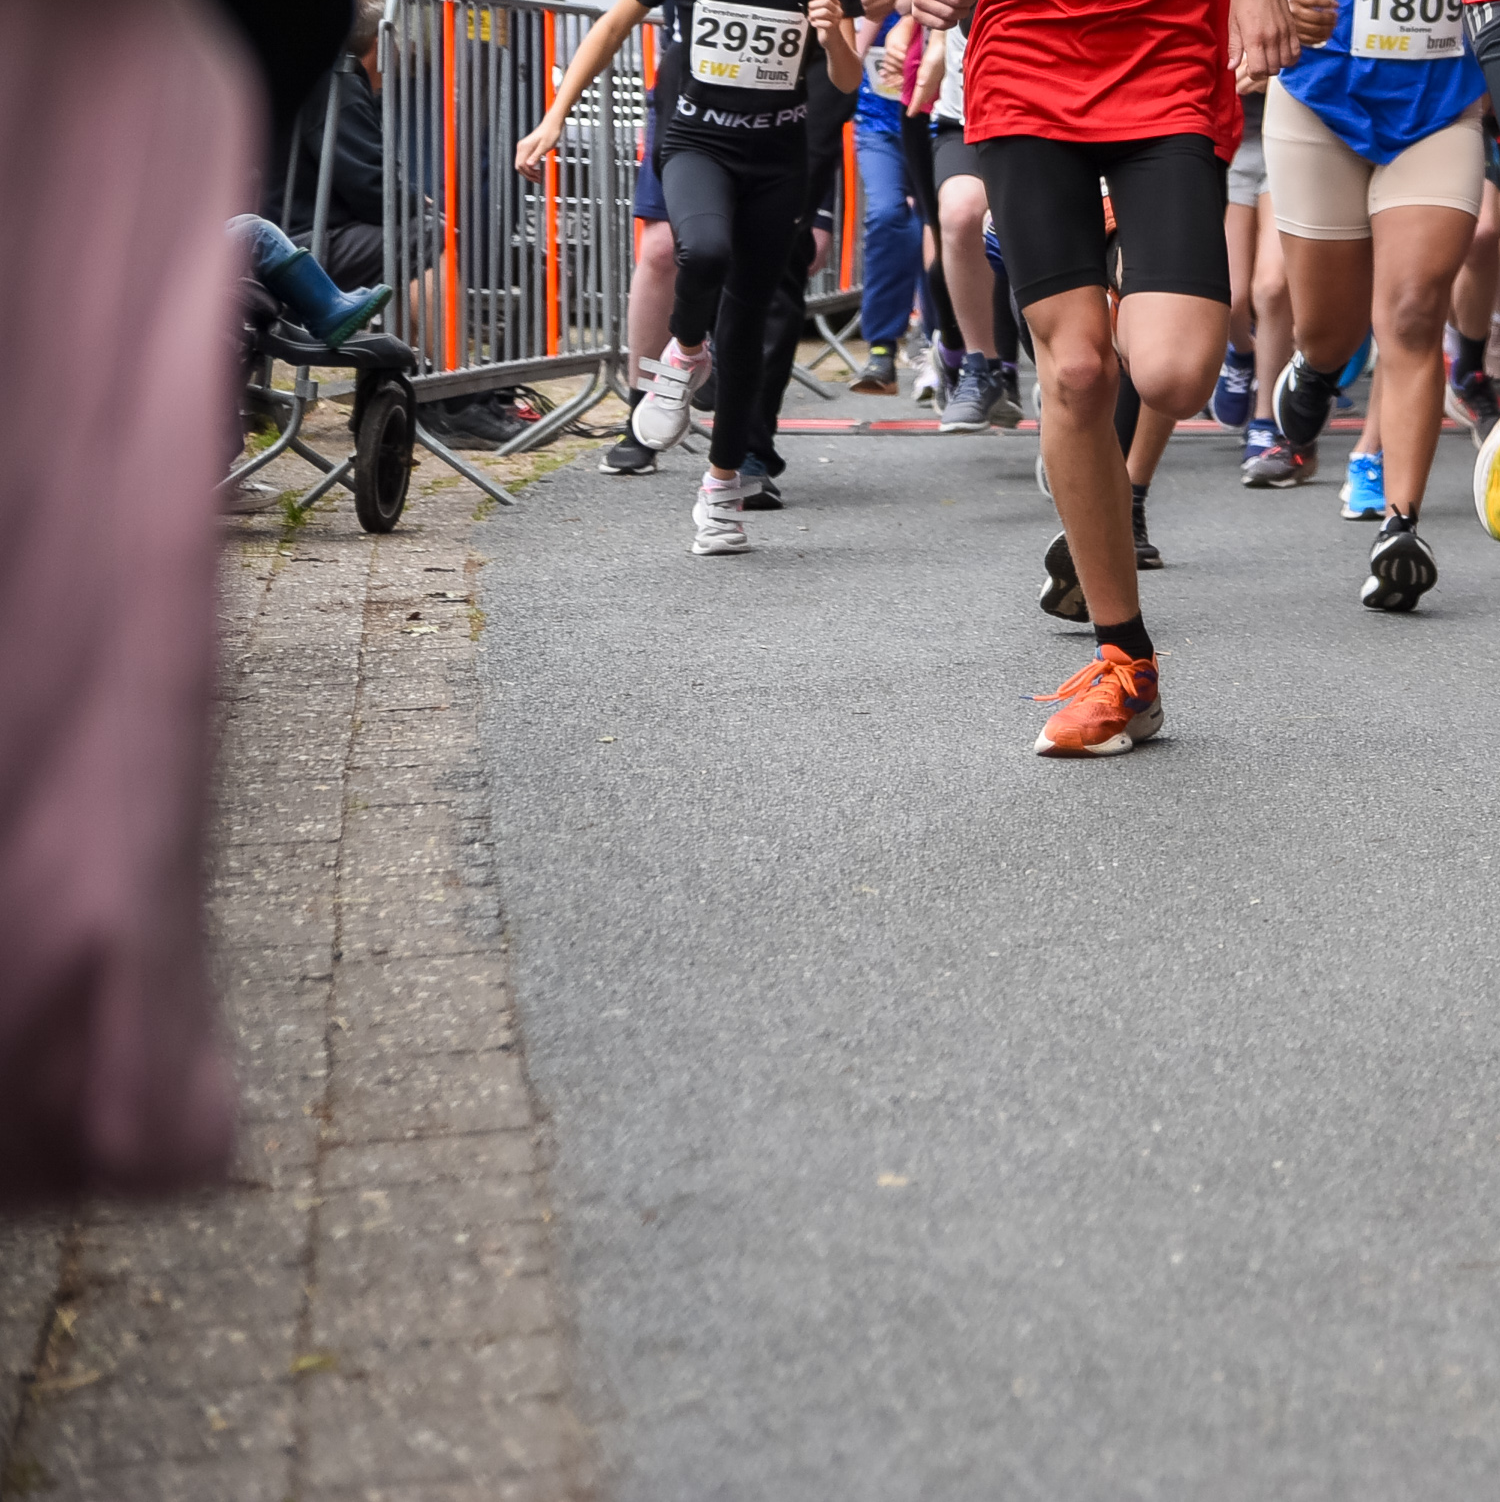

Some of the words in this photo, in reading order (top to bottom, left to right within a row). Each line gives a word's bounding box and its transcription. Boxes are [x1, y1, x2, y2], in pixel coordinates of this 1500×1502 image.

[694, 16, 804, 58] 2958
[1365, 33, 1412, 52] EWE
[1426, 35, 1458, 50] bruns
[698, 59, 741, 80] EWE
[755, 65, 790, 82] bruns
[702, 109, 774, 129] NIKE
[775, 104, 808, 127] PR
